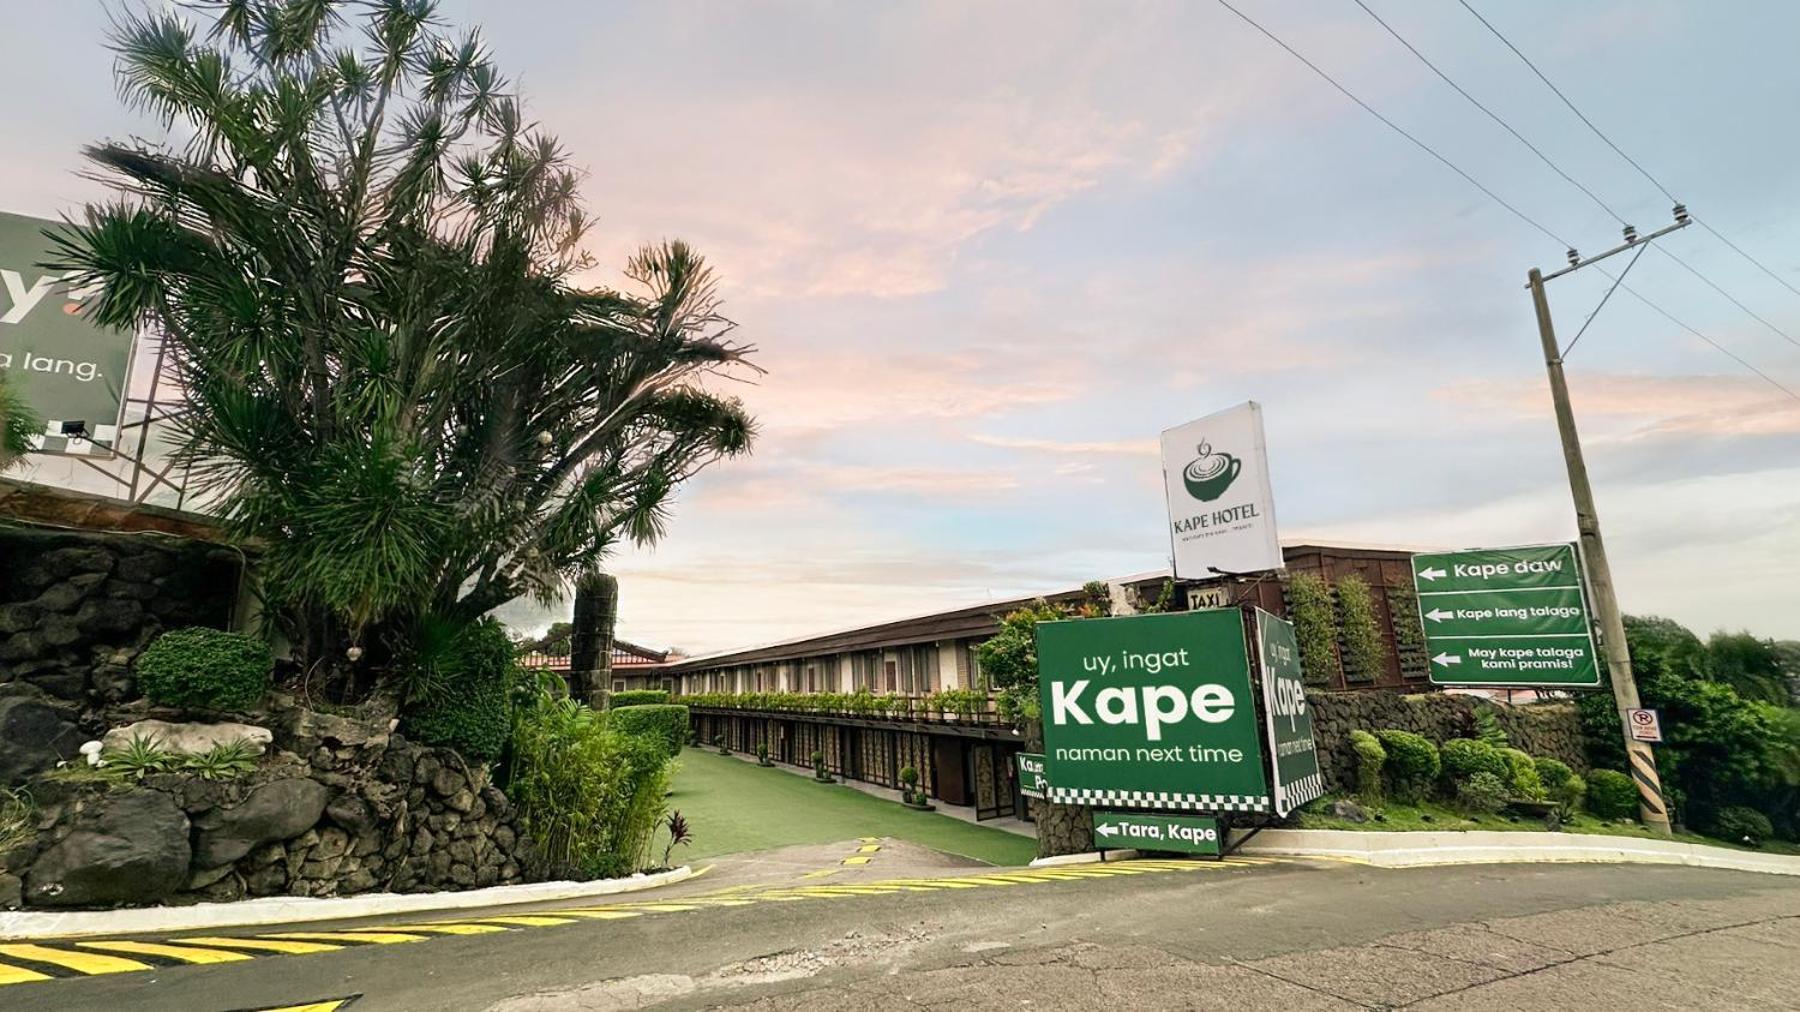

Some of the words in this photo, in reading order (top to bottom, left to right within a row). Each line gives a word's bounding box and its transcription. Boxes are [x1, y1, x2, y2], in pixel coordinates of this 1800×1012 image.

[23, 352, 103, 382] lang.
[1174, 514, 1209, 534] KAPE
[1212, 503, 1260, 526] HOTEL
[1454, 563, 1510, 580] Kape
[1514, 559, 1563, 575] daw
[1190, 593, 1220, 609] TAXI
[1456, 608, 1493, 621] Kape
[1494, 607, 1528, 619] lang
[1530, 605, 1580, 619] talaga
[1083, 655, 1117, 676] uy,
[1122, 648, 1190, 674] ingat
[1468, 648, 1497, 660] May
[1499, 647, 1535, 661] kape
[1536, 647, 1584, 660] talaga
[1481, 658, 1516, 669] kami
[1518, 657, 1574, 671] pramis!
[1051, 679, 1236, 741] Kape
[1266, 666, 1307, 733] Kape
[1056, 747, 1131, 761] naman
[1136, 745, 1184, 763] next
[1189, 744, 1244, 763] time
[1118, 821, 1165, 841] Tara,
[1167, 823, 1217, 846] Kape
